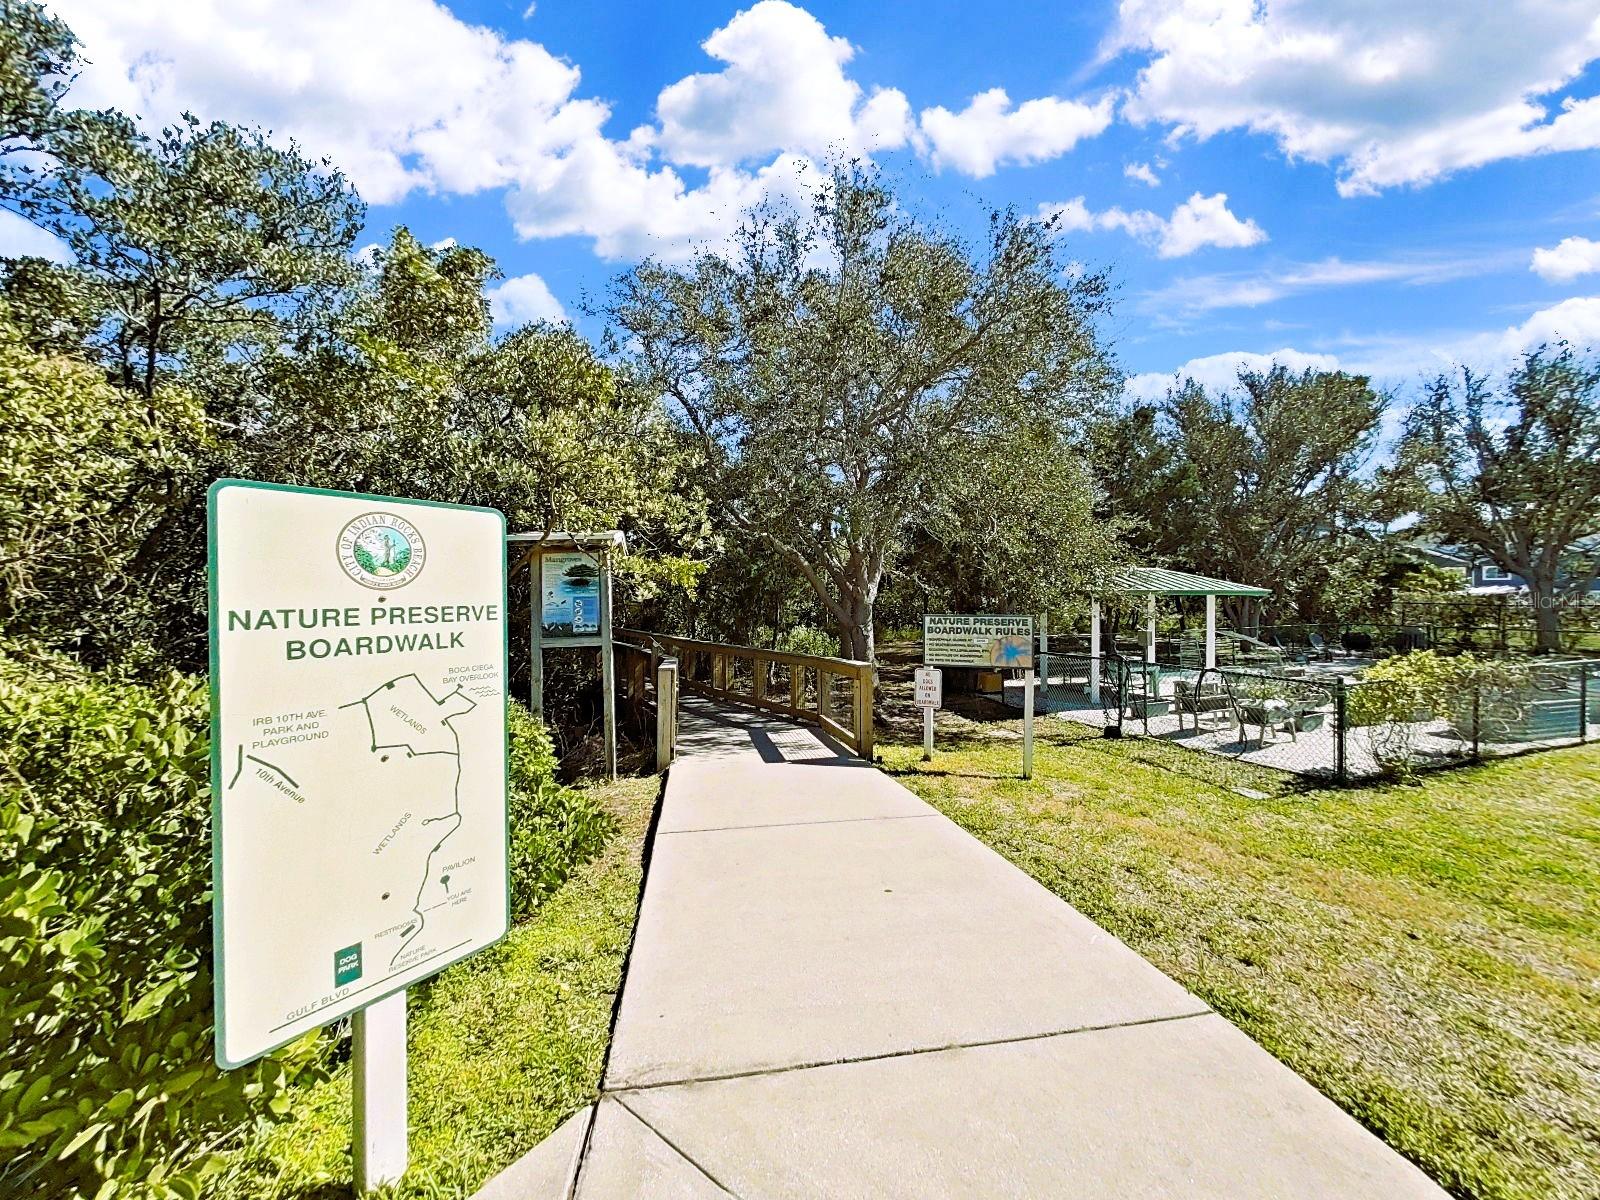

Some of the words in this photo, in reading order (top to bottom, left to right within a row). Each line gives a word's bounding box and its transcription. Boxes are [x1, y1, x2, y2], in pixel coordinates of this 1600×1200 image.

[347, 515, 386, 536] INDIAN
[390, 517, 420, 544] ROCKS
[340, 536, 353, 550] OF
[341, 555, 362, 577] CITY
[404, 547, 423, 578] BEACH
[228, 607, 360, 631] NATURE
[370, 605, 499, 626] PRESERVE
[929, 617, 970, 626] NATURE
[973, 617, 1029, 626] PRESERVE
[927, 626, 992, 636] BOARDWALK
[995, 627, 1031, 636] RULES
[286, 631, 465, 660] BOARDWALK
[442, 676, 458, 684] BAY
[459, 671, 499, 683] OVERLOOK
[448, 666, 470, 675] BOCA
[472, 664, 494, 672] CIEGA
[252, 716, 273, 727] IRB
[276, 712, 304, 724] 10TH
[263, 724, 294, 737] PARK
[296, 721, 320, 732] AND
[389, 704, 428, 735] WETLANDS
[252, 730, 329, 750] PLAYGROUND
[255, 767, 275, 784] 10th
[273, 780, 306, 804] Avenue
[372, 811, 412, 855] WETLANDS
[442, 856, 476, 873] PAVILION
[338, 960, 359, 975] PARK
[339, 953, 358, 966] DOG
[286, 1000, 318, 1021] GULF
[320, 987, 350, 1006] BLVD
